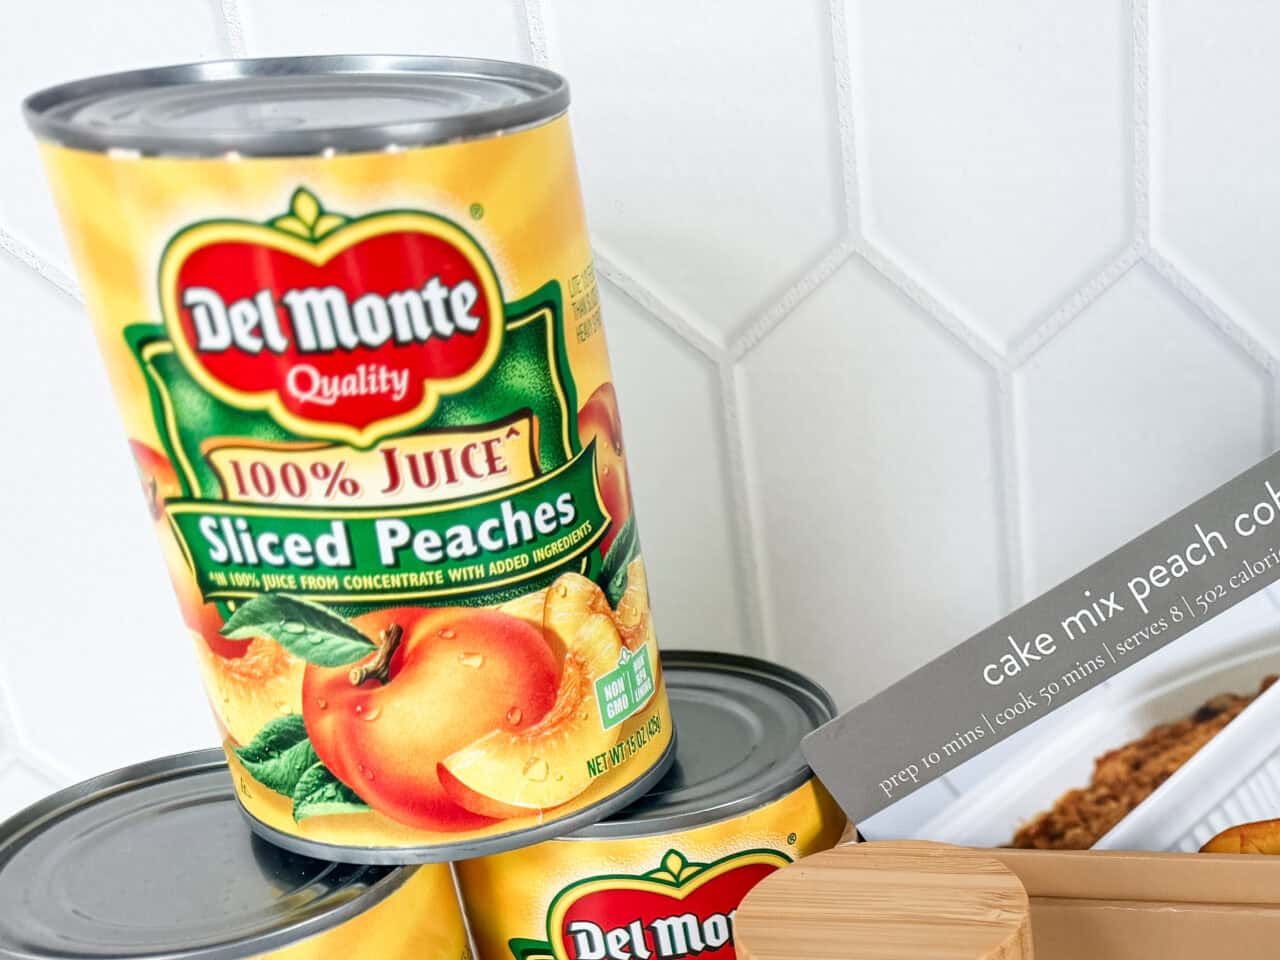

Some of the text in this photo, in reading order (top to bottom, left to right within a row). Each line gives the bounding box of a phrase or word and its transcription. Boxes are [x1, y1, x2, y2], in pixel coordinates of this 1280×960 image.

[183, 285, 289, 353] Del
[283, 275, 481, 353] Monte
[286, 364, 410, 407] Quality
[229, 457, 361, 500] 100%
[198, 491, 577, 567] Sliced Peaches
[261, 573, 296, 592] JUICE
[301, 575, 338, 590] FROM
[344, 567, 444, 590] CONCENTRATE
[448, 562, 485, 584] WITH
[488, 554, 530, 576] ADDED
[532, 520, 593, 564] INGREDIENTS
[983, 635, 1057, 686] cake
[1061, 590, 1124, 641] mix
[1127, 523, 1229, 614] peach
[878, 764, 920, 798] prep
[942, 728, 986, 758] mins
[995, 691, 1038, 727] cook
[1039, 682, 1060, 706] 50
[1061, 654, 1106, 687] mins
[1116, 616, 1169, 655] serves
[1169, 604, 1185, 624] 8
[1195, 584, 1227, 616] 502
[587, 752, 608, 777] NET
[609, 741, 626, 766] WT
[627, 735, 637, 755] 15
[651, 909, 737, 960] Mo
